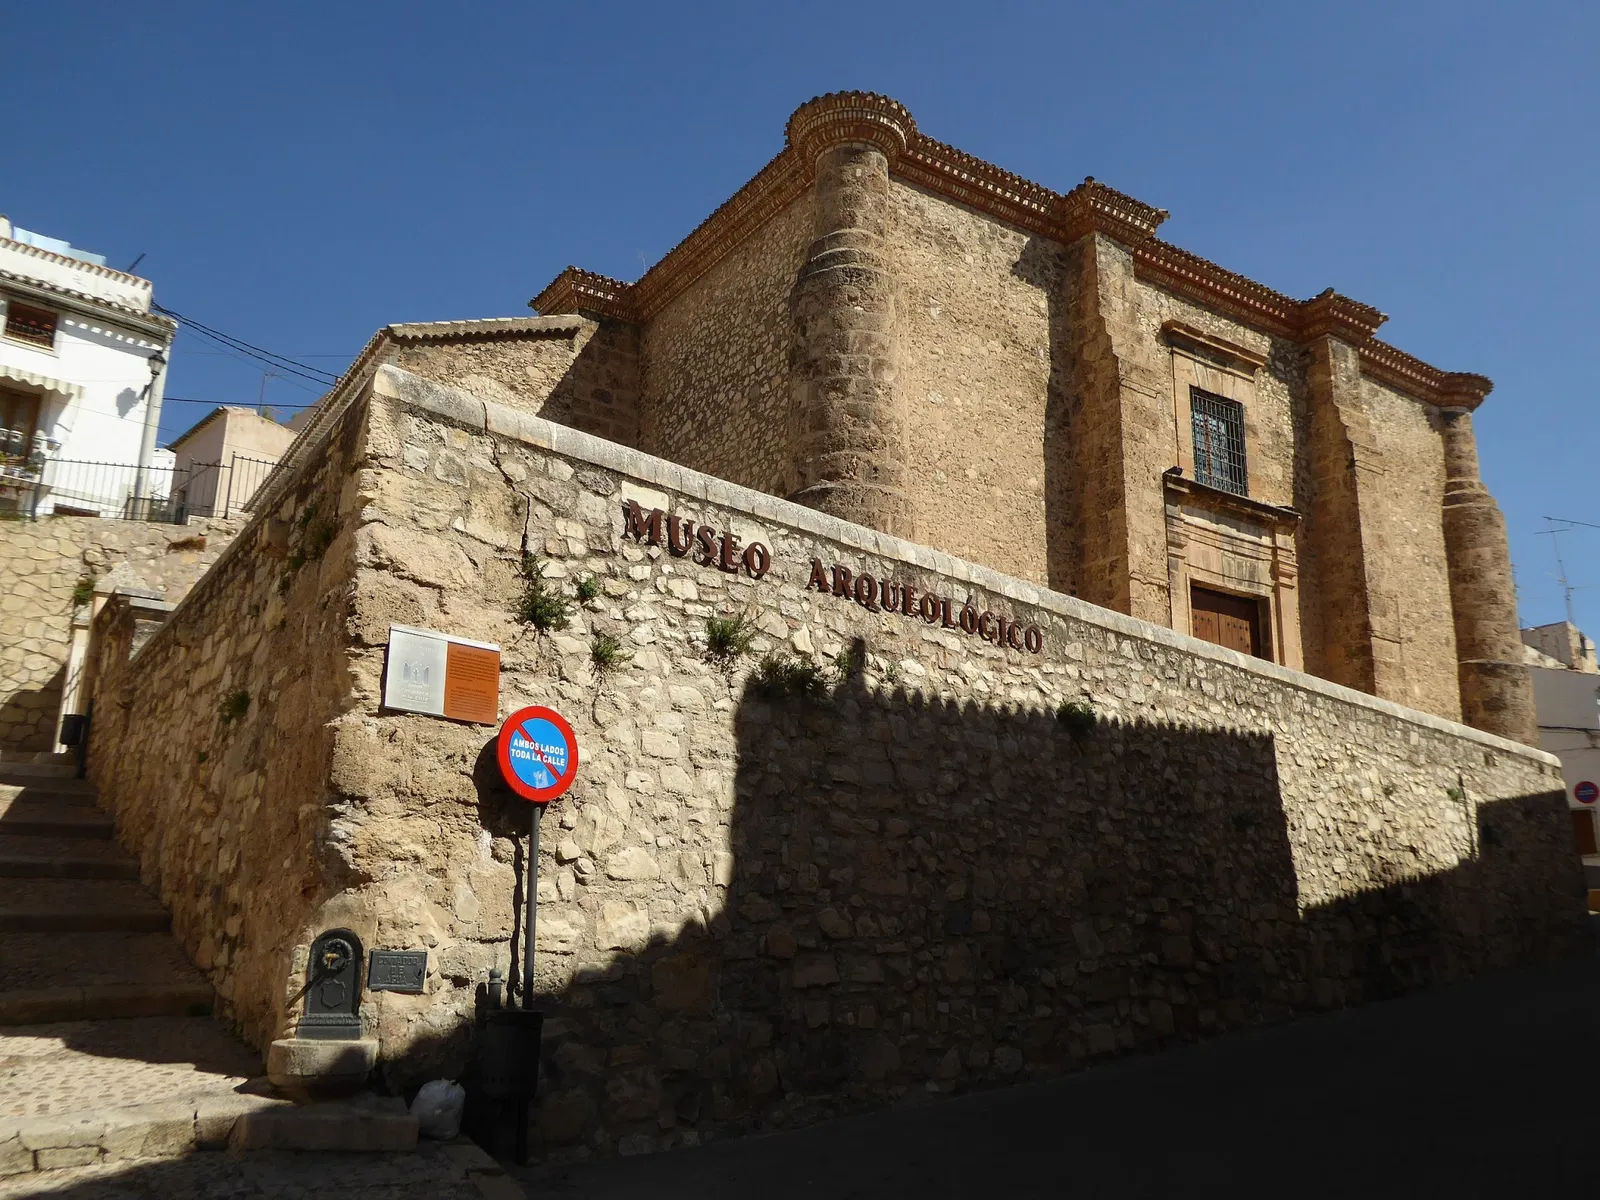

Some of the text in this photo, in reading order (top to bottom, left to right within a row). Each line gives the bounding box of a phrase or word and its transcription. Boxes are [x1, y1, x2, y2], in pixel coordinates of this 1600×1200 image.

[626, 499, 1043, 654] MUSEO ARQUEOLÓGICO
[513, 738, 565, 756] AMBOS LADOS
[511, 748, 566, 767] TODA LA CALLE
